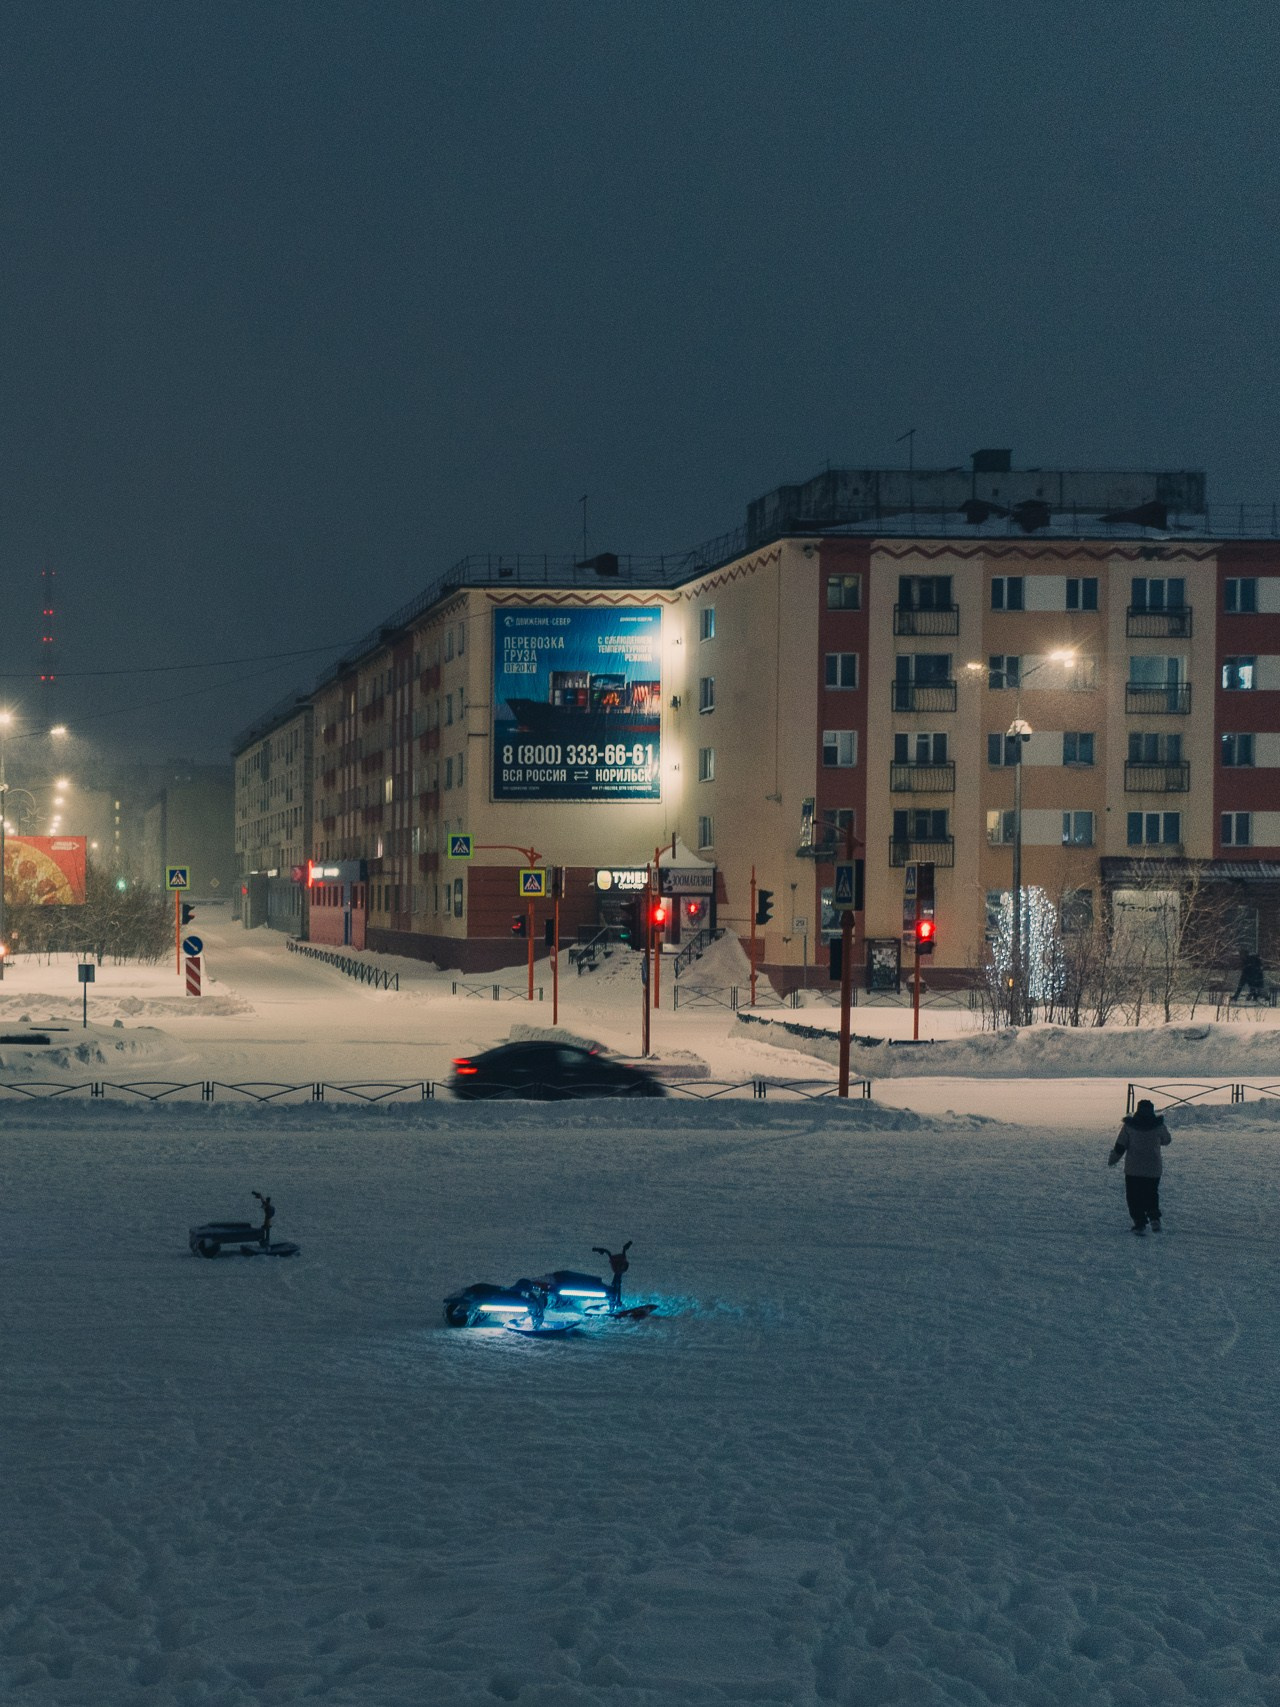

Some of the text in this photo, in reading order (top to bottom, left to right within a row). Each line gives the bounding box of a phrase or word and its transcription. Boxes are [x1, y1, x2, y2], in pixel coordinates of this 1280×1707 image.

[504, 636, 565, 649] ПЕРЕВОЗКА
[504, 649, 538, 662] ГРУЗА
[505, 663, 536, 673] ОТ 20 КГ
[503, 743, 653, 766] 8 (800) 333-66-61
[503, 768, 652, 782] ВСЯ РОССИЯ НОРИЛЬСК
[672, 874, 712, 887] ЗООМАГАЗИН
